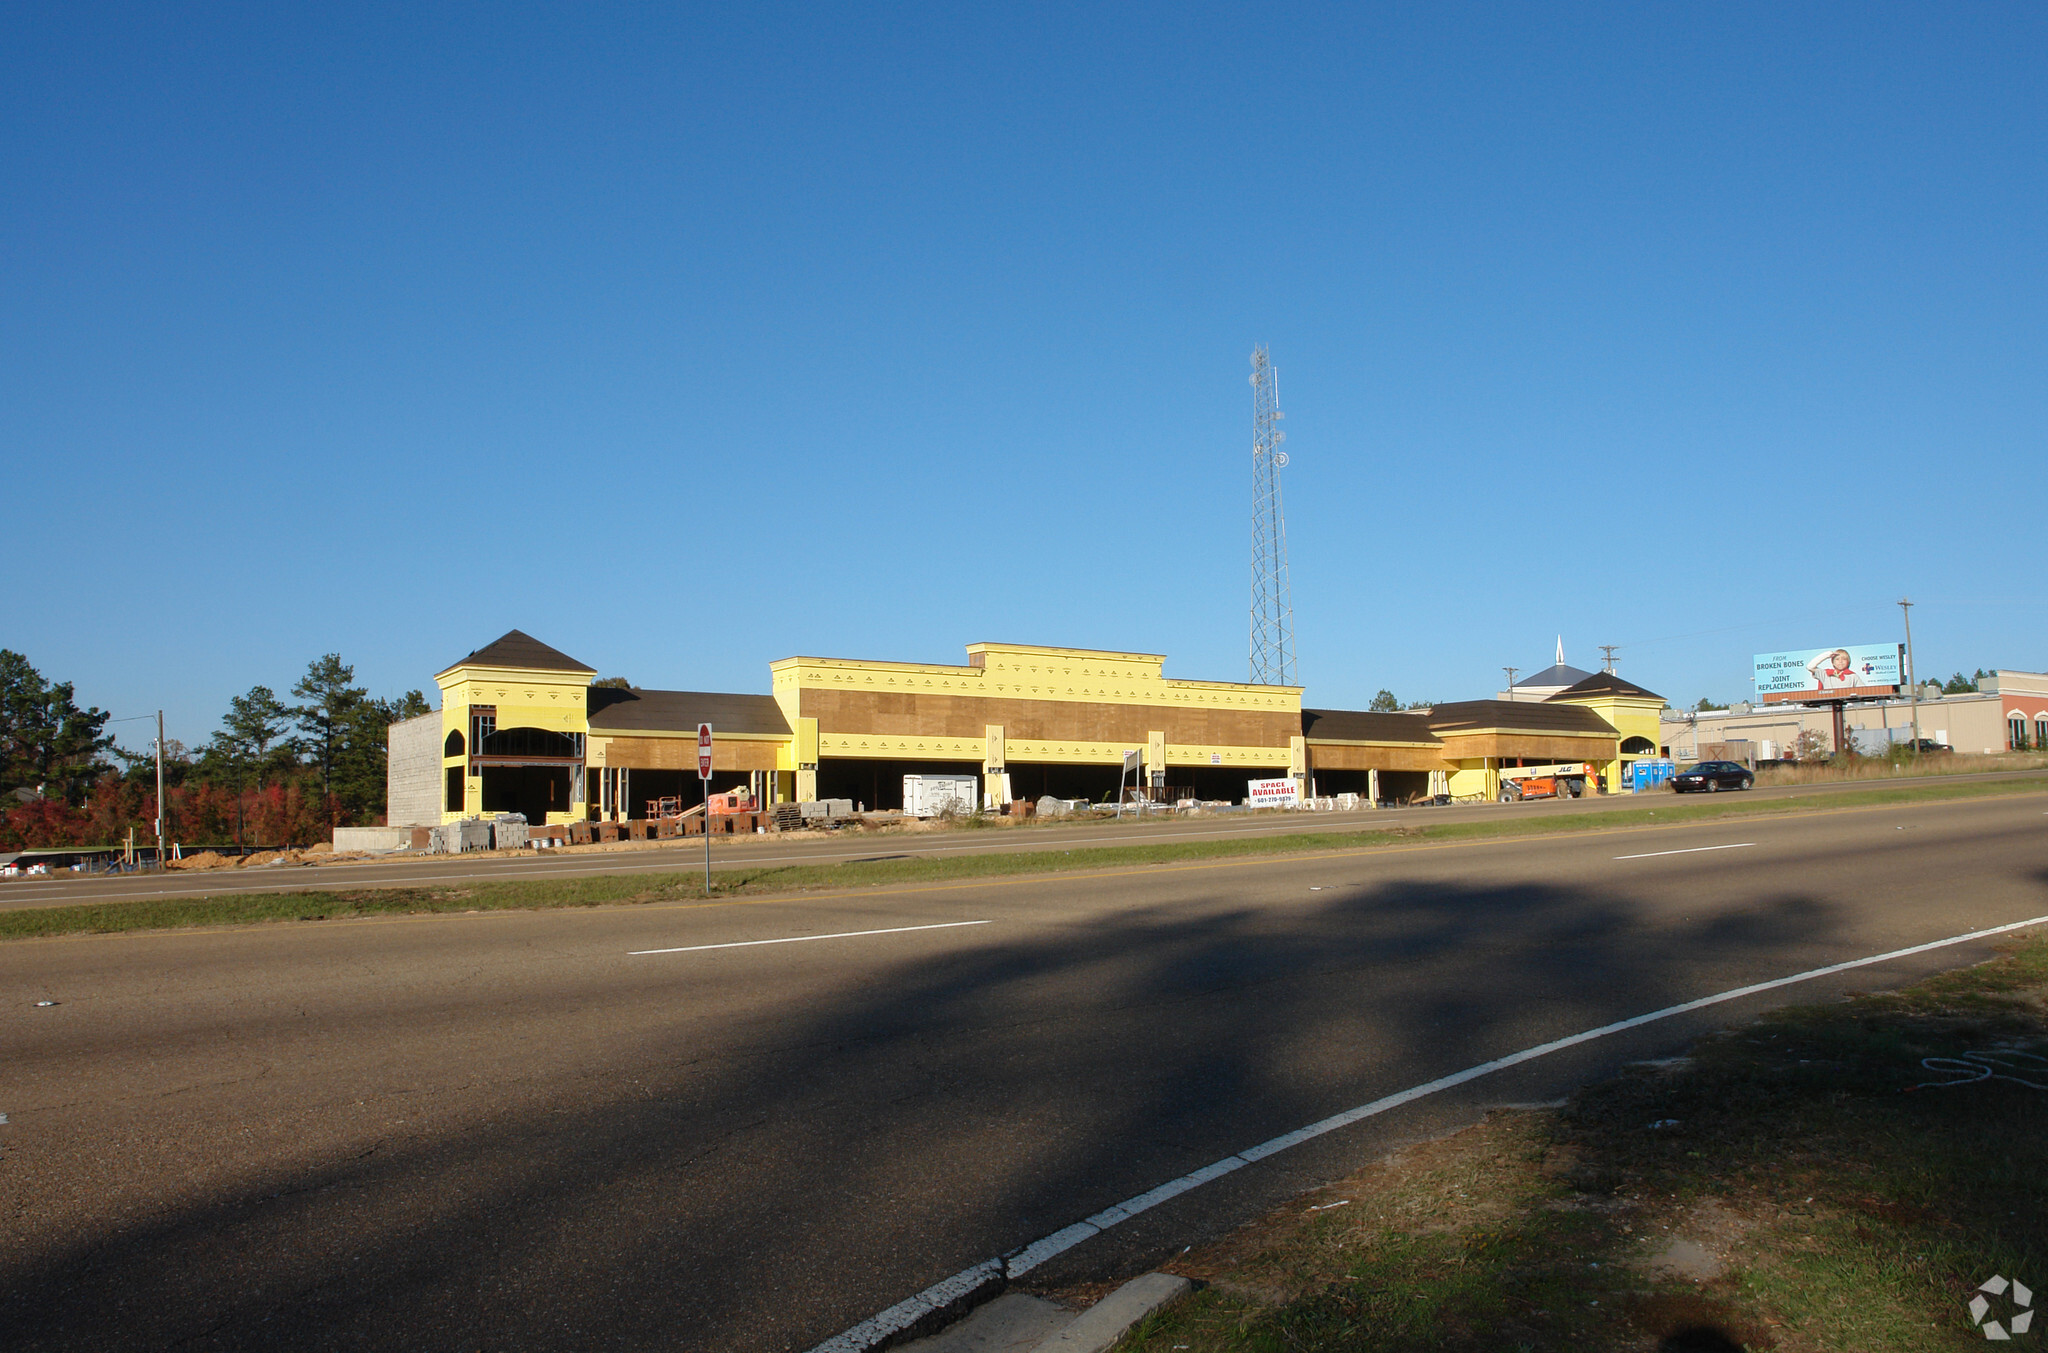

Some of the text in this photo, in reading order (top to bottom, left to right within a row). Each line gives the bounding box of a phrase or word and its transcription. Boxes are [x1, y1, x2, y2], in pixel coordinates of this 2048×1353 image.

[1756, 660, 1804, 670] BROKEN BONES
[1771, 675, 1790, 683] JOINT
[1758, 681, 1805, 690] REPLACEMENTS
[1252, 786, 1296, 796] AVAILABLE
